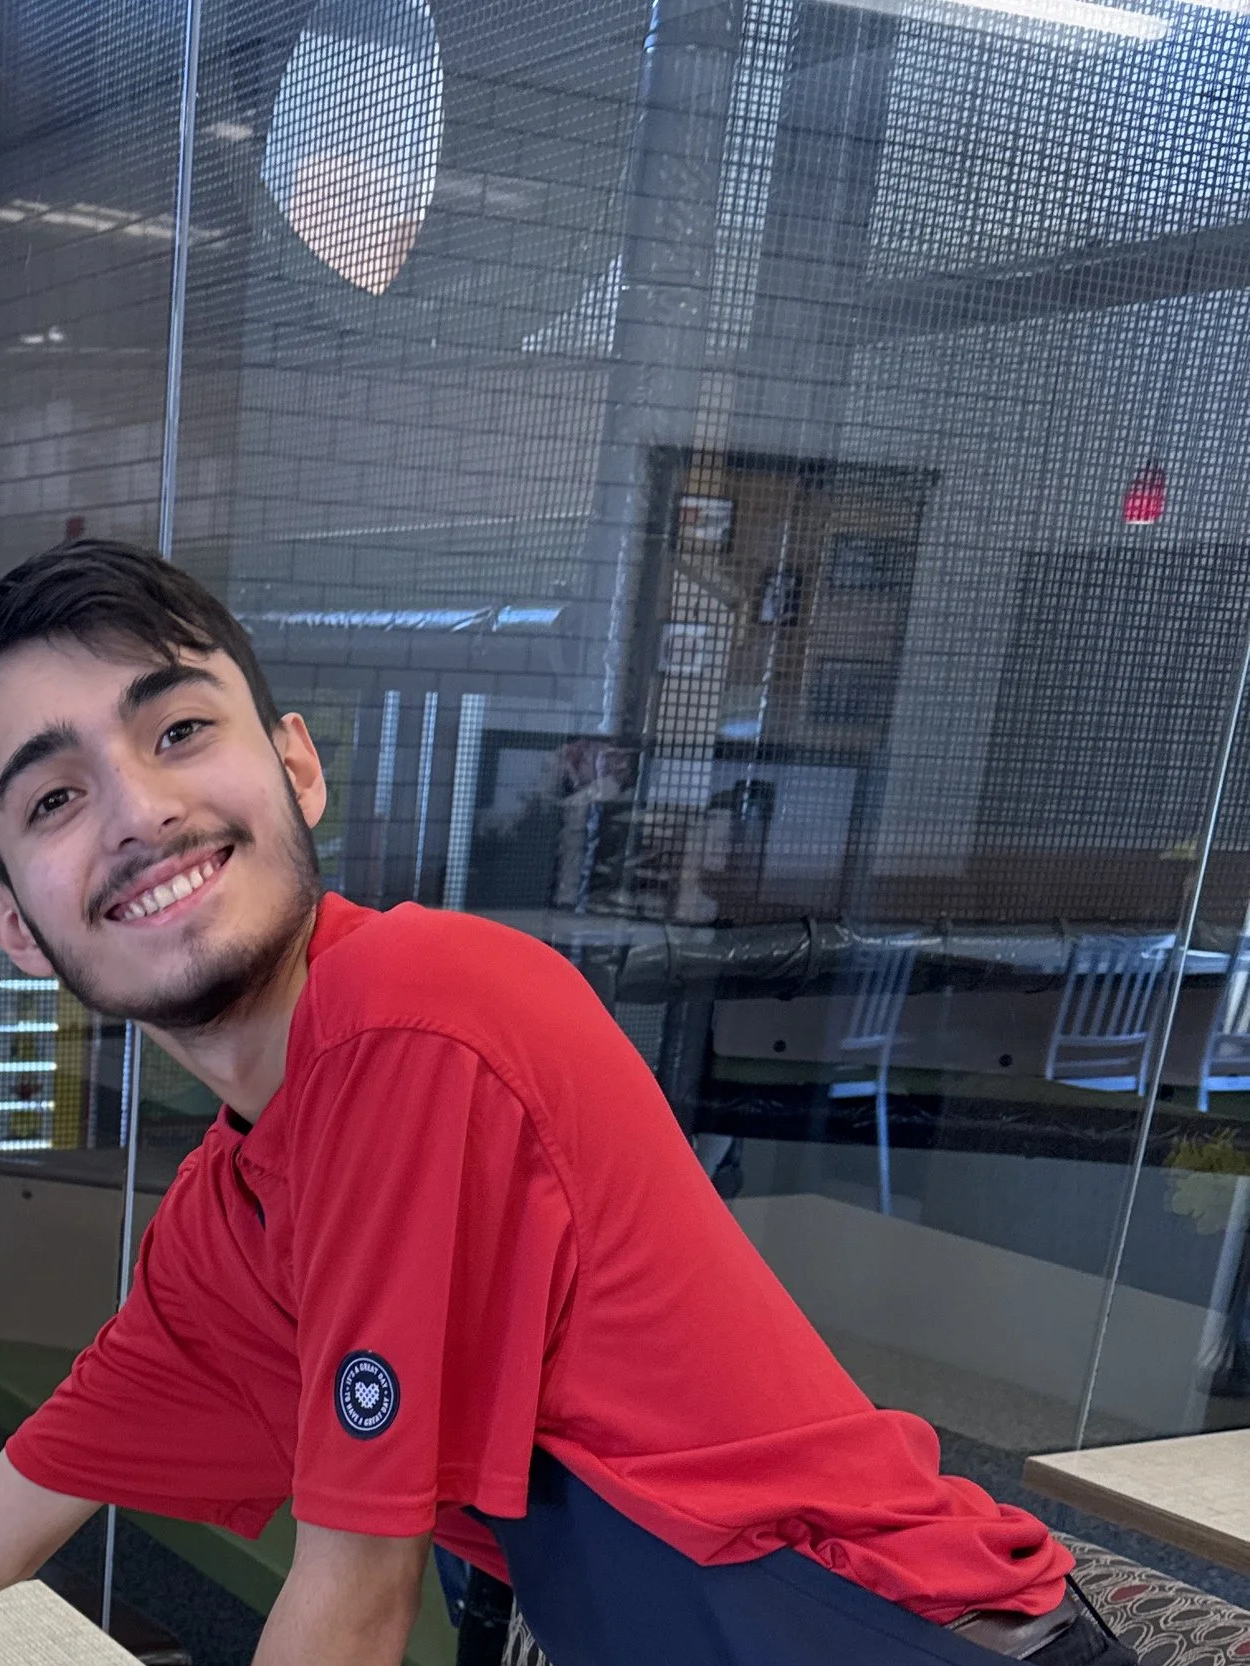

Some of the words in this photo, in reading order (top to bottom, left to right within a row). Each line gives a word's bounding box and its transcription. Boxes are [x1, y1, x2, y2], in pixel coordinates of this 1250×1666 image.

[359, 1362, 379, 1375] GREAT
[378, 1372, 388, 1388] DAY
[344, 1391, 351, 1403] TO
[380, 1397, 390, 1414] DAY
[346, 1403, 359, 1422] HAVE
[363, 1411, 383, 1427] GREAT
